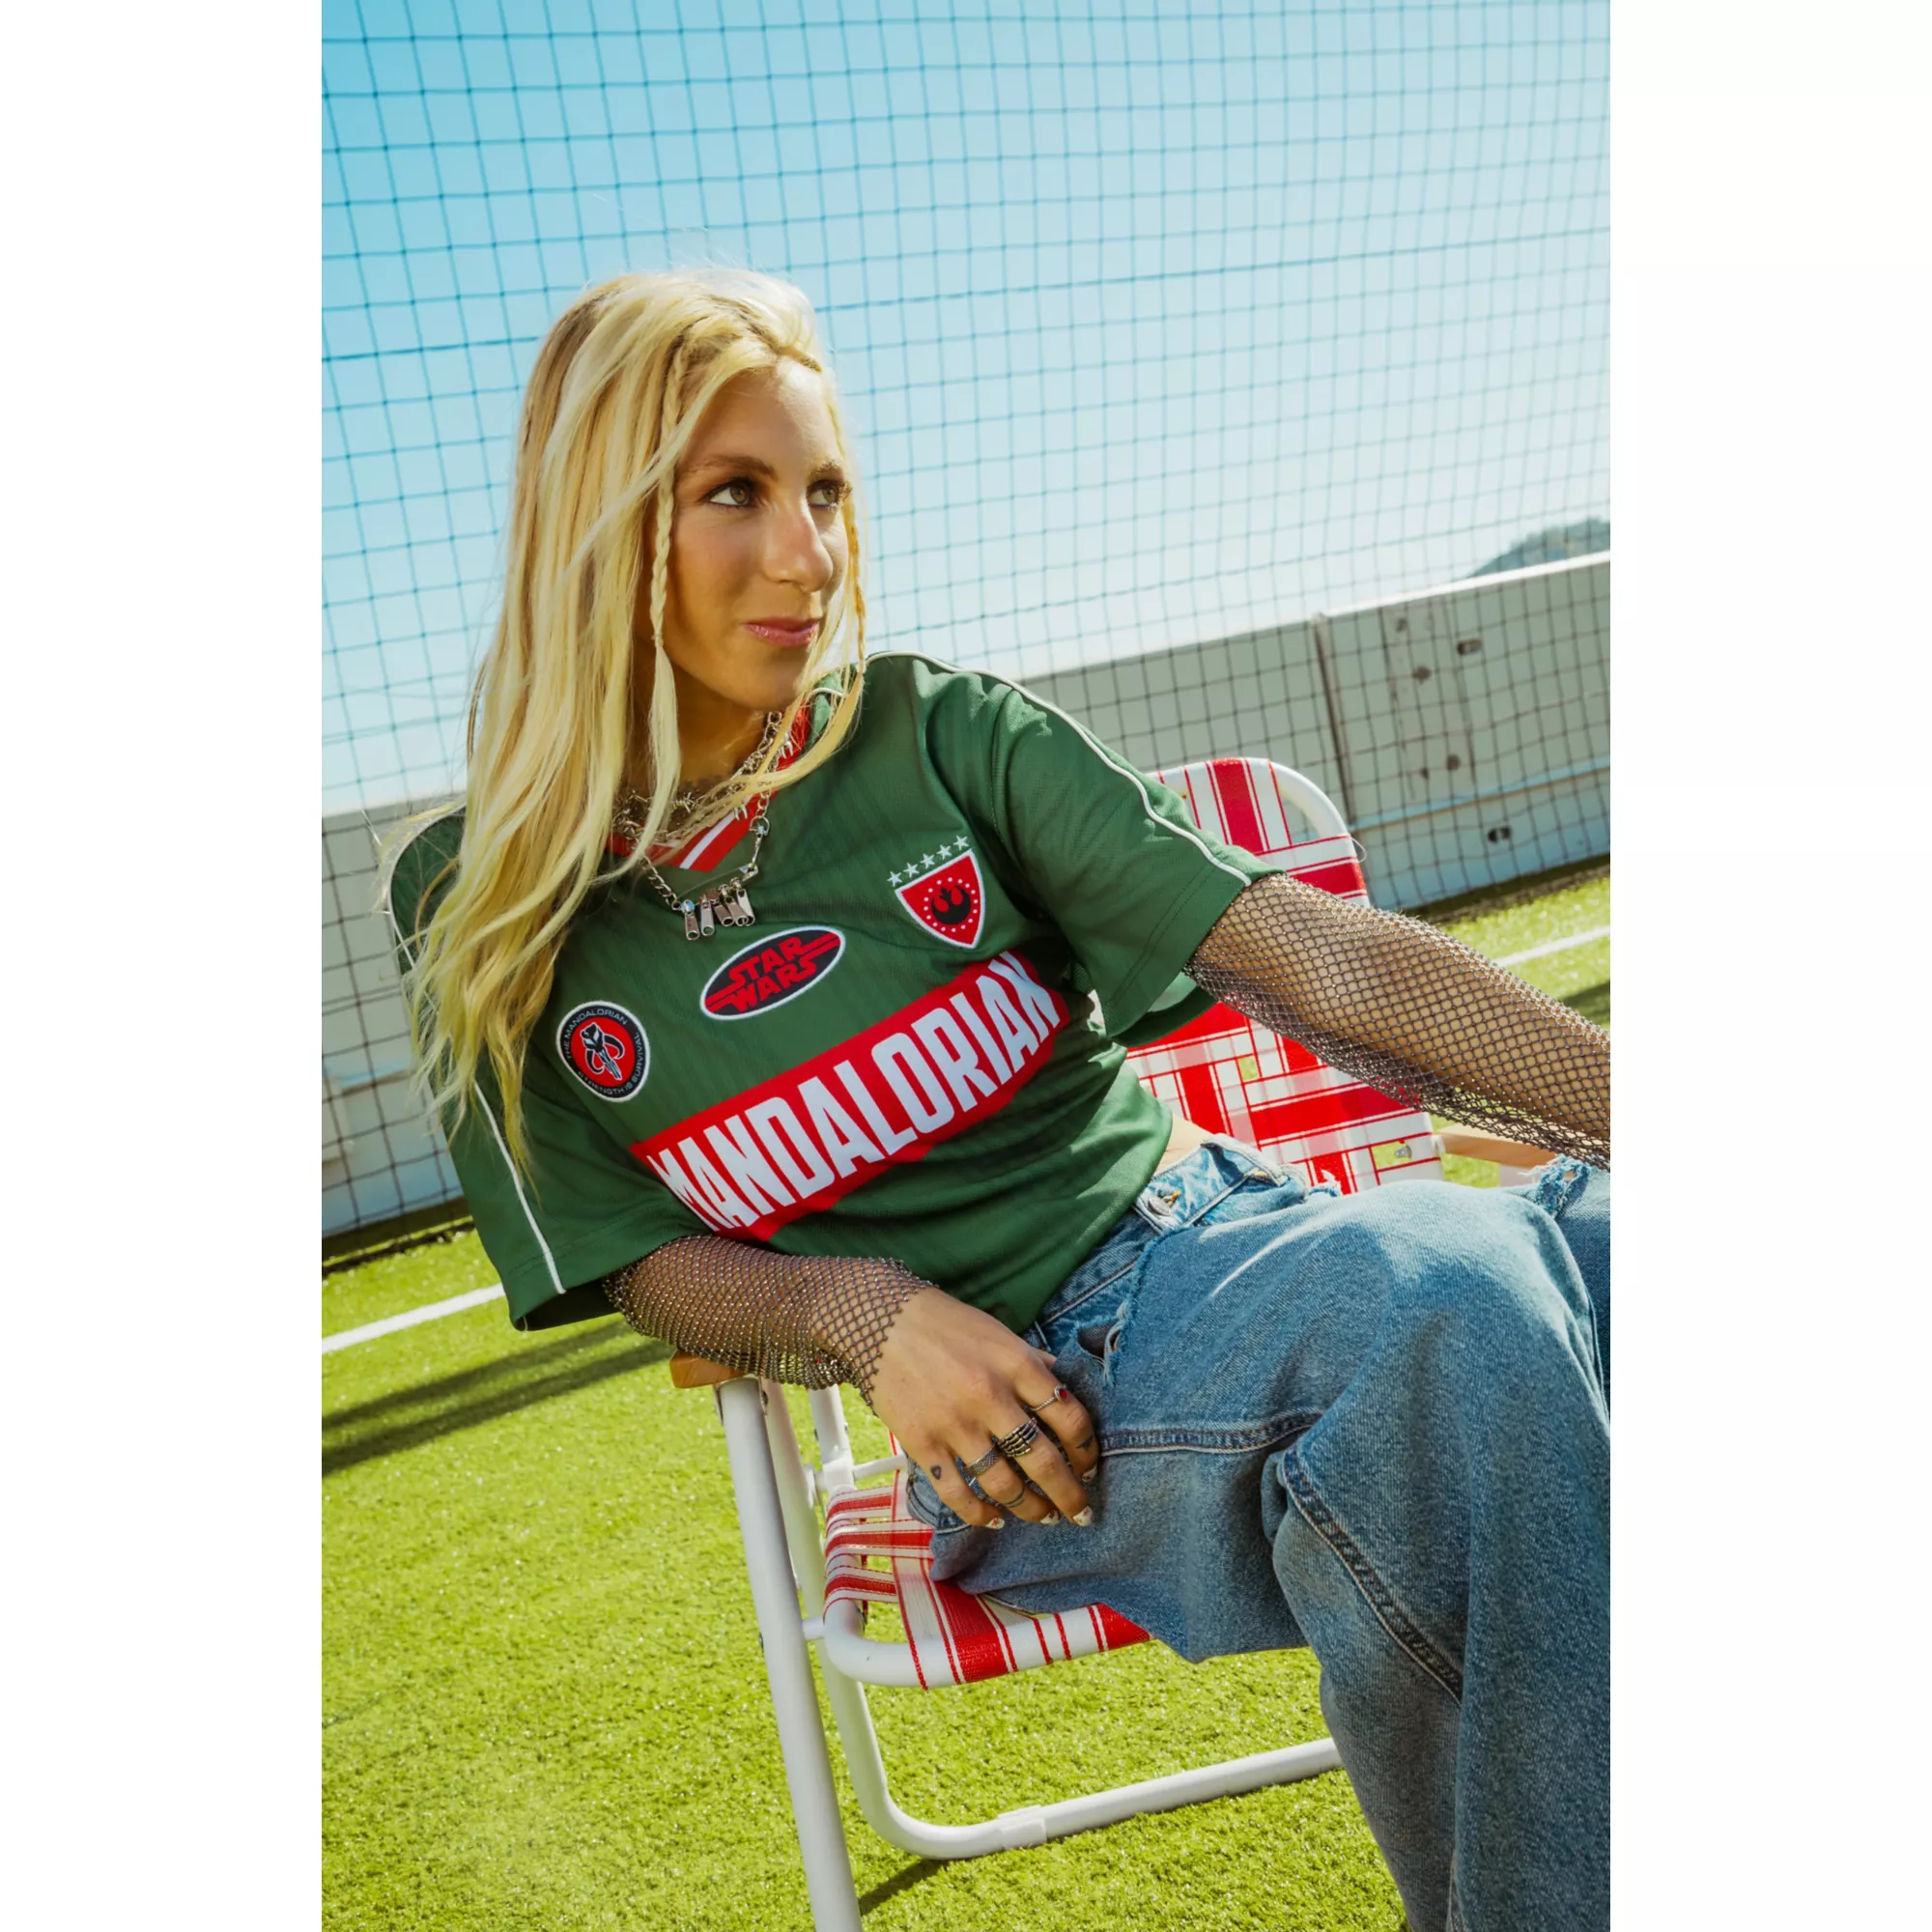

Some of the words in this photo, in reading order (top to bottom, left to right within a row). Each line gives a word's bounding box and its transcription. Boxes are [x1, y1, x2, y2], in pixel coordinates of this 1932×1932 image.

[564, 1008, 628, 1039] MANDALORIAN
[578, 1070, 625, 1095] STRENGTH
[625, 1081, 634, 1091] IS
[631, 1031, 644, 1083] SURVIVAL
[645, 951, 1061, 1232] MANDALORIAN
